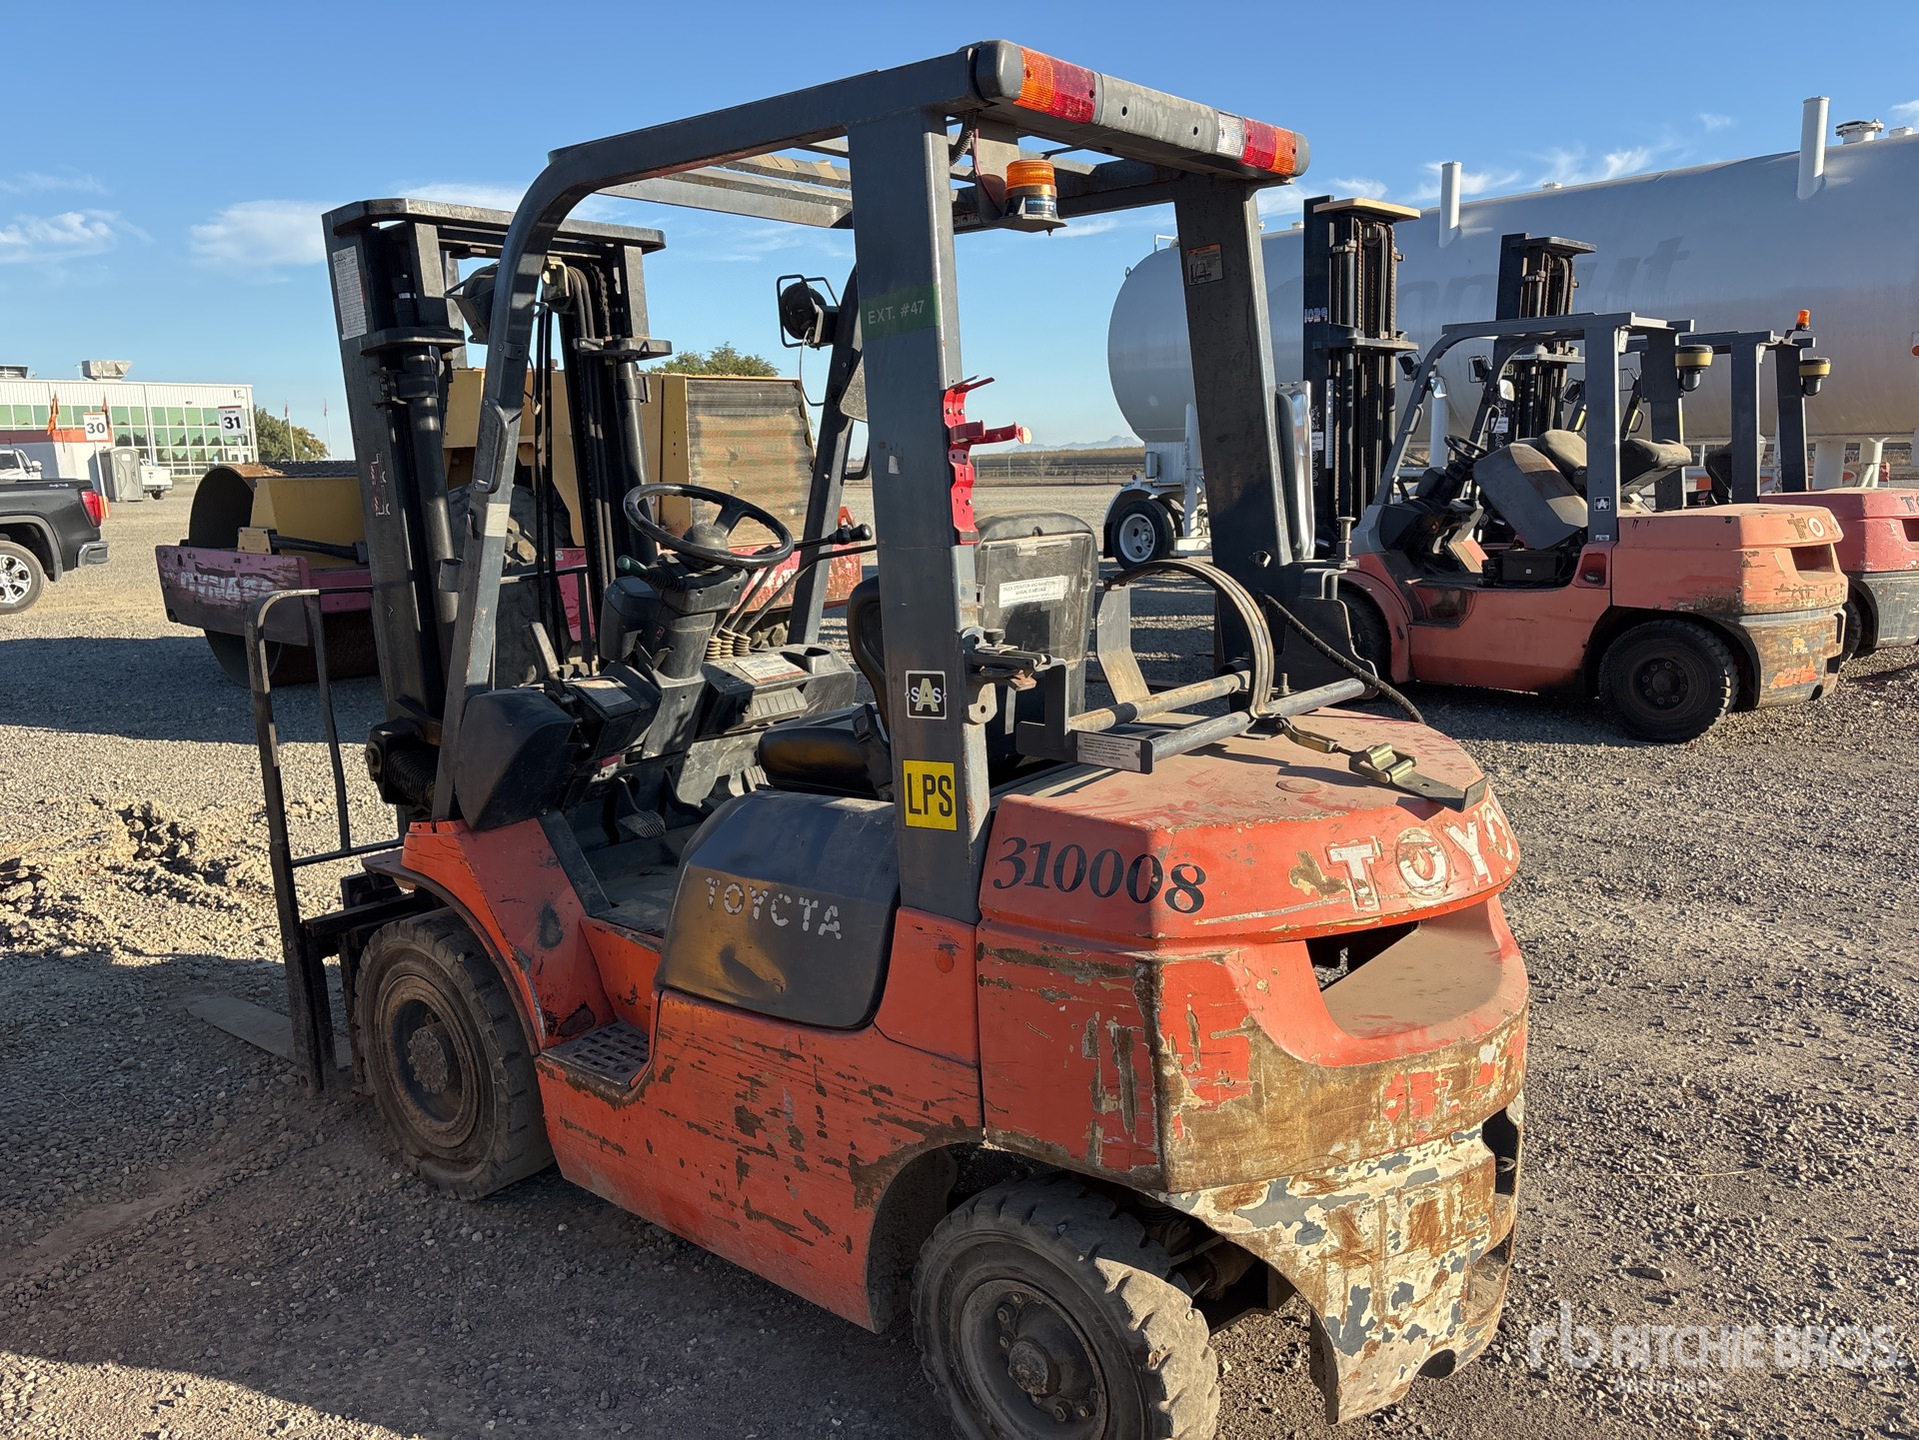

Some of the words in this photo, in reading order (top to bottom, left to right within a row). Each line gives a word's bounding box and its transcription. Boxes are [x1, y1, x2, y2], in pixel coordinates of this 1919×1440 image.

[868, 306, 895, 325] EXT.
[901, 299, 925, 318] #47
[86, 422, 106, 434] 30
[223, 416, 242, 430] 31
[910, 678, 943, 712] SAS
[907, 773, 953, 817] LPS
[993, 836, 1207, 914] 310008
